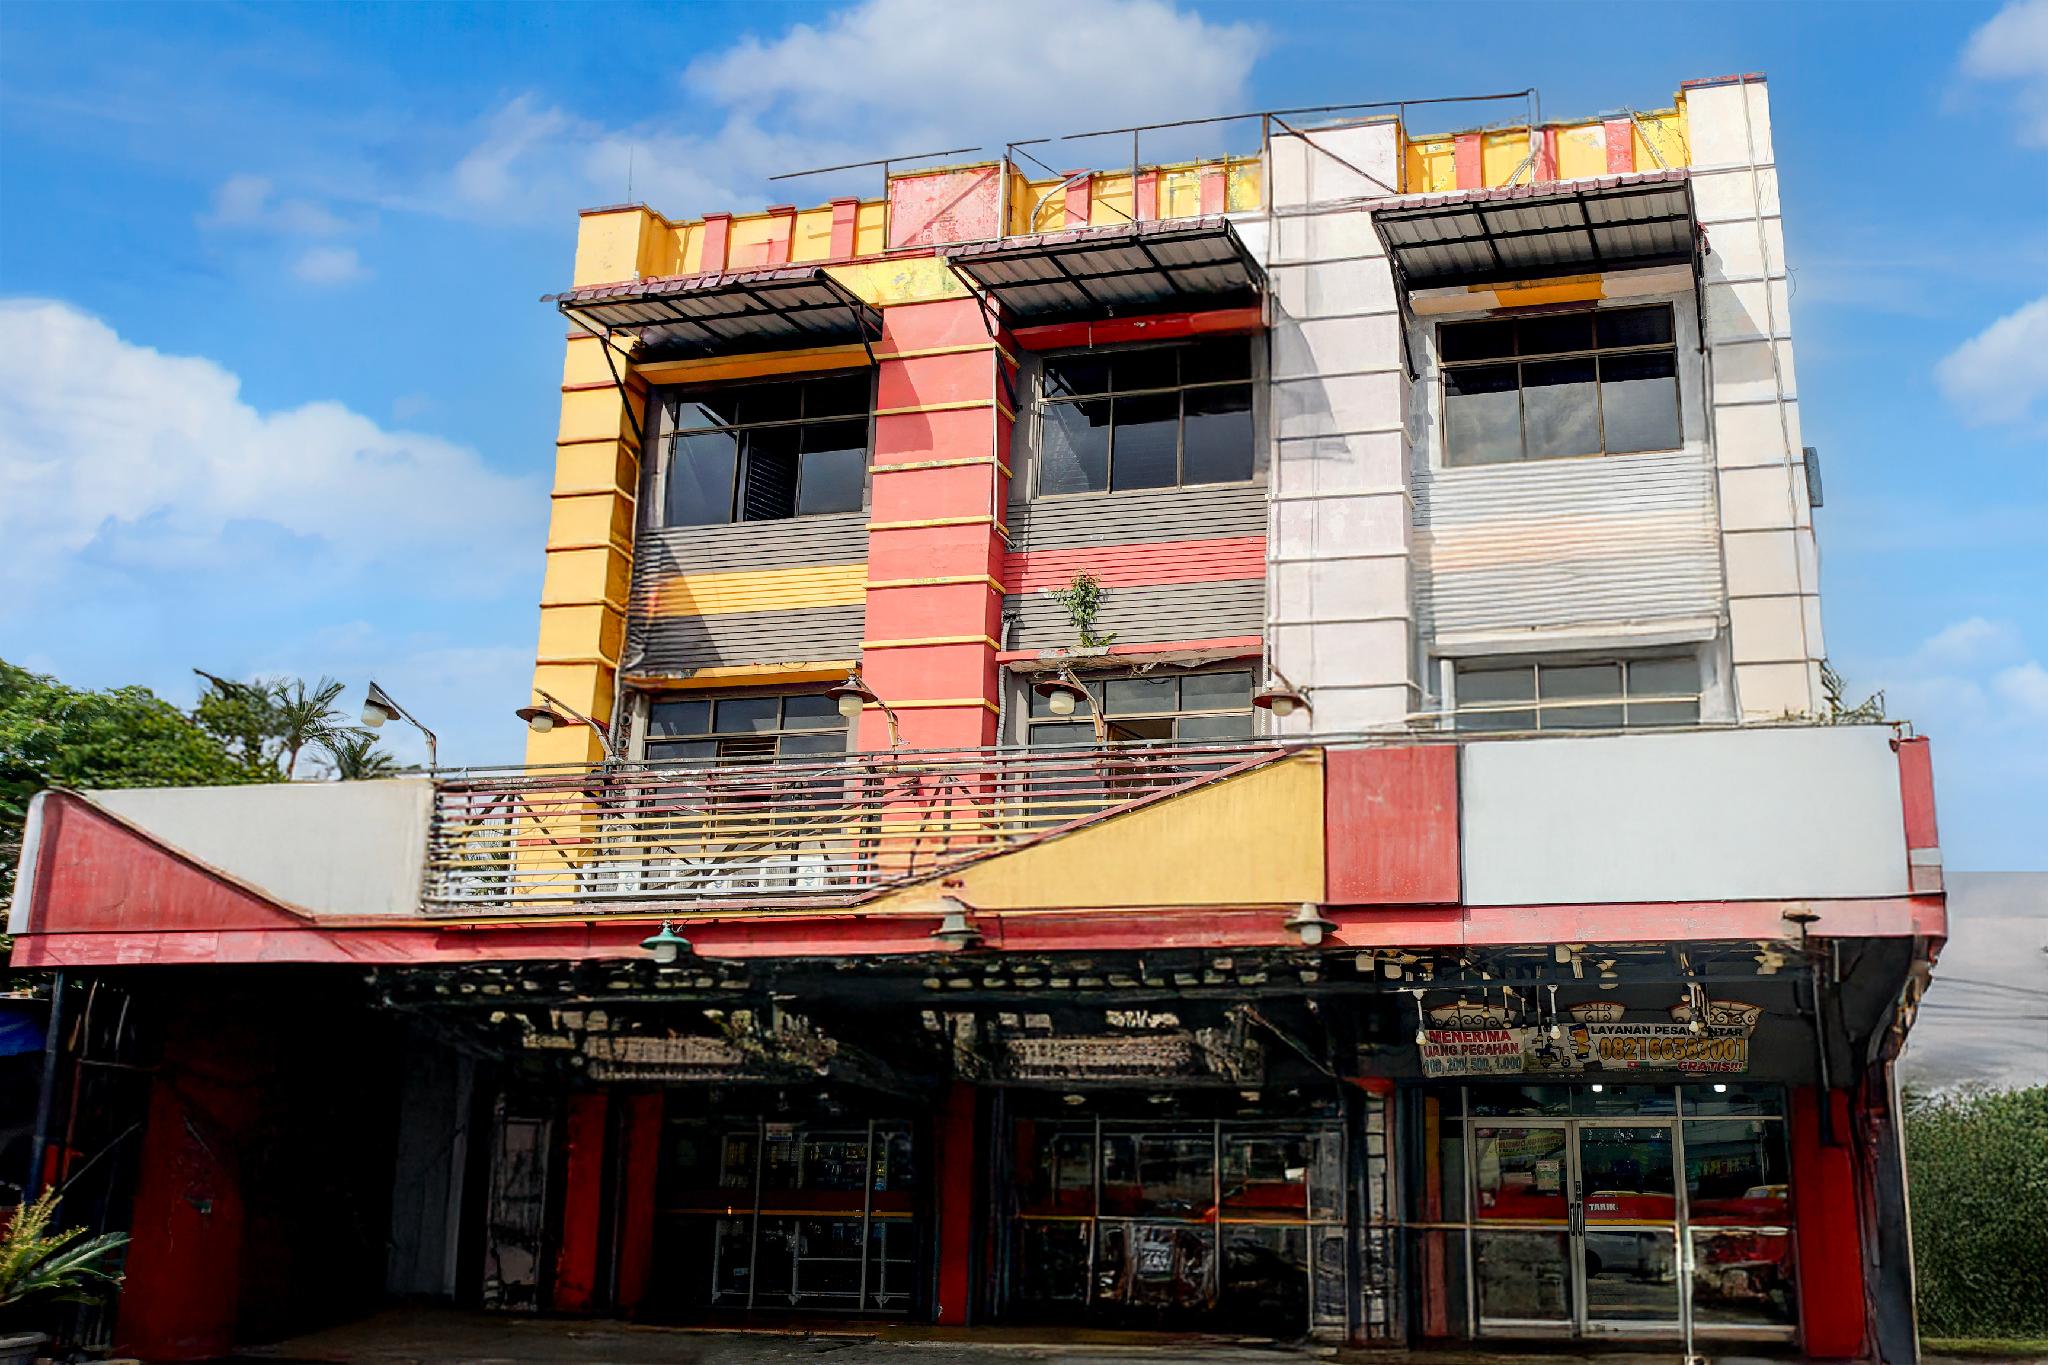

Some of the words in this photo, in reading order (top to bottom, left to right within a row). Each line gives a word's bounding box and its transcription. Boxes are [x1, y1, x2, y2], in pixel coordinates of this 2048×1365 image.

[1591, 1025, 1651, 1035] LAYANAN
[1428, 1030, 1512, 1043] MENERIMA
[1423, 1044, 1458, 1057] UANG
[1461, 1043, 1519, 1056] PECAHAN
[1677, 1061, 1744, 1073] GRATIS!!!
